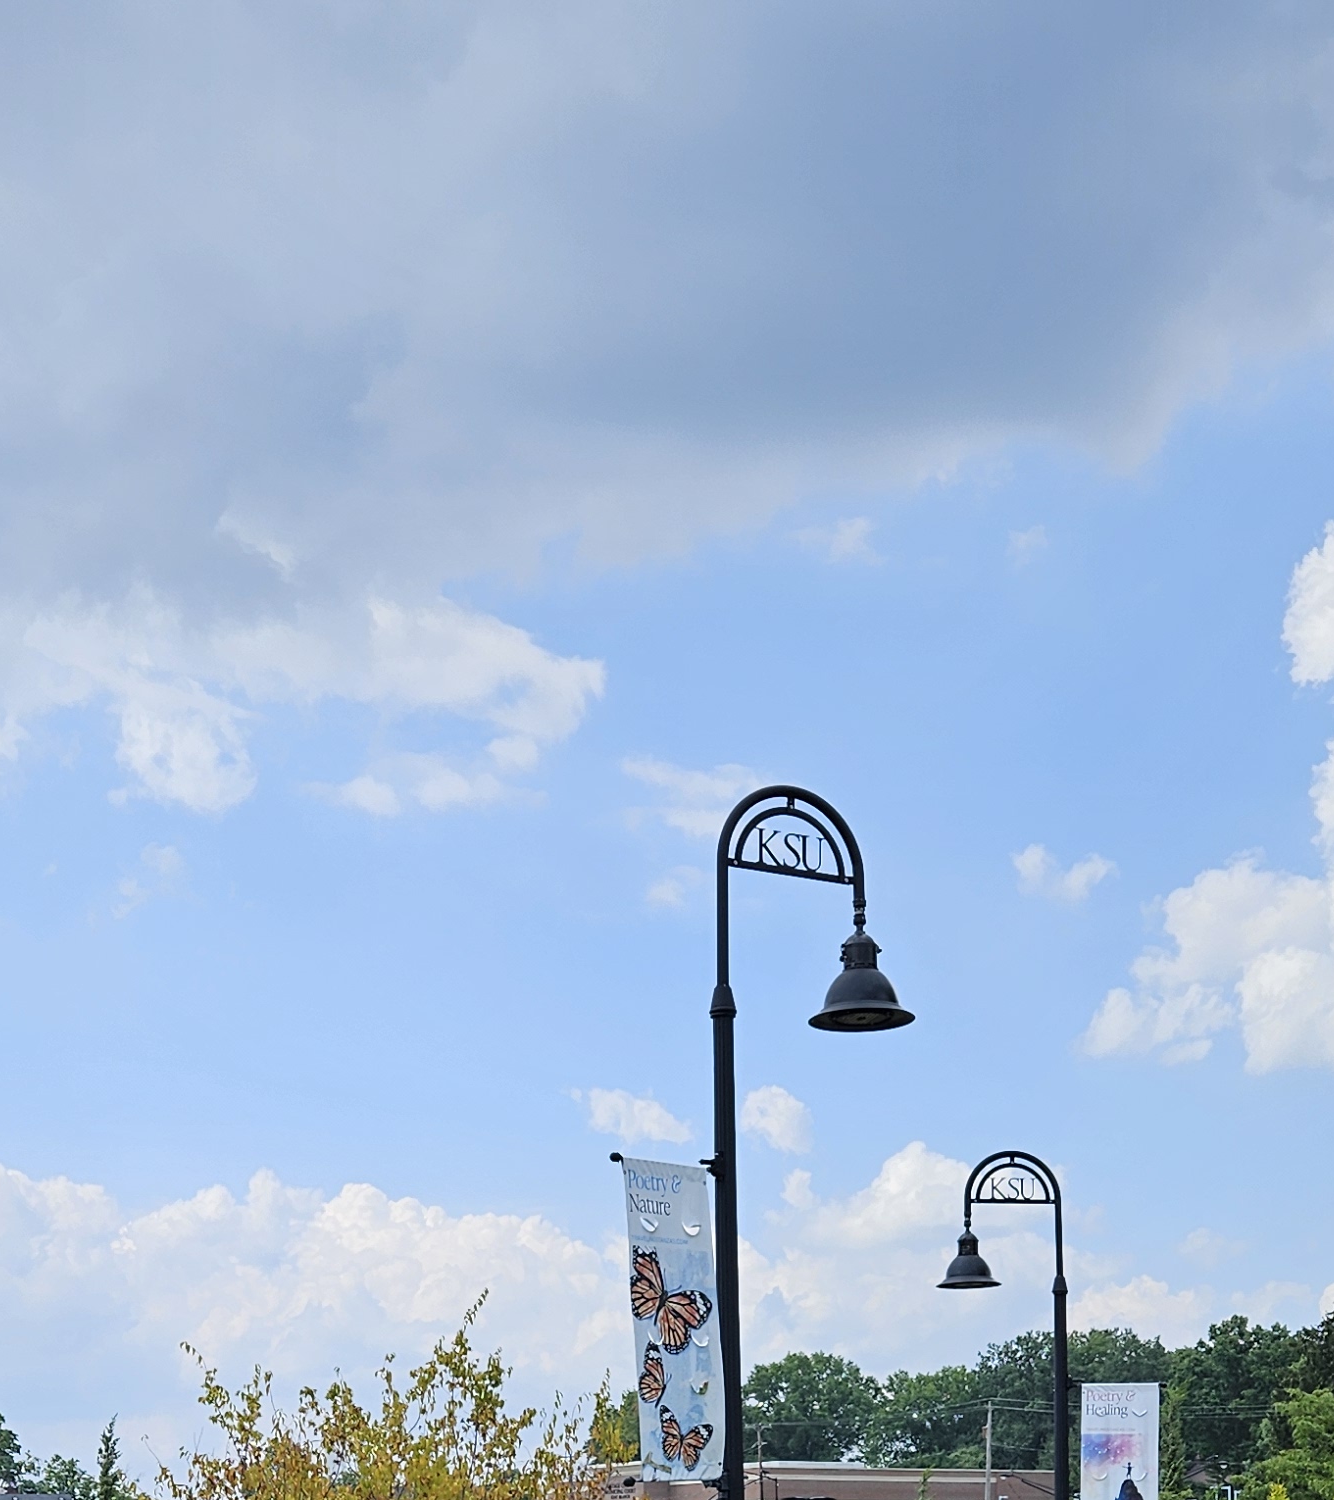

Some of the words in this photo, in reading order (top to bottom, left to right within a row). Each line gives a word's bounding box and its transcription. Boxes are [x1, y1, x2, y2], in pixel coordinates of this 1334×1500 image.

[755, 826, 825, 870] KSU
[628, 1169, 667, 1197] Poetry
[671, 1174, 682, 1194] &
[990, 1177, 1036, 1201] KSU
[629, 1193, 671, 1216] Nature
[1086, 1390, 1123, 1406] Poetry
[1126, 1390, 1136, 1402] &
[1086, 1403, 1129, 1419] Healing
